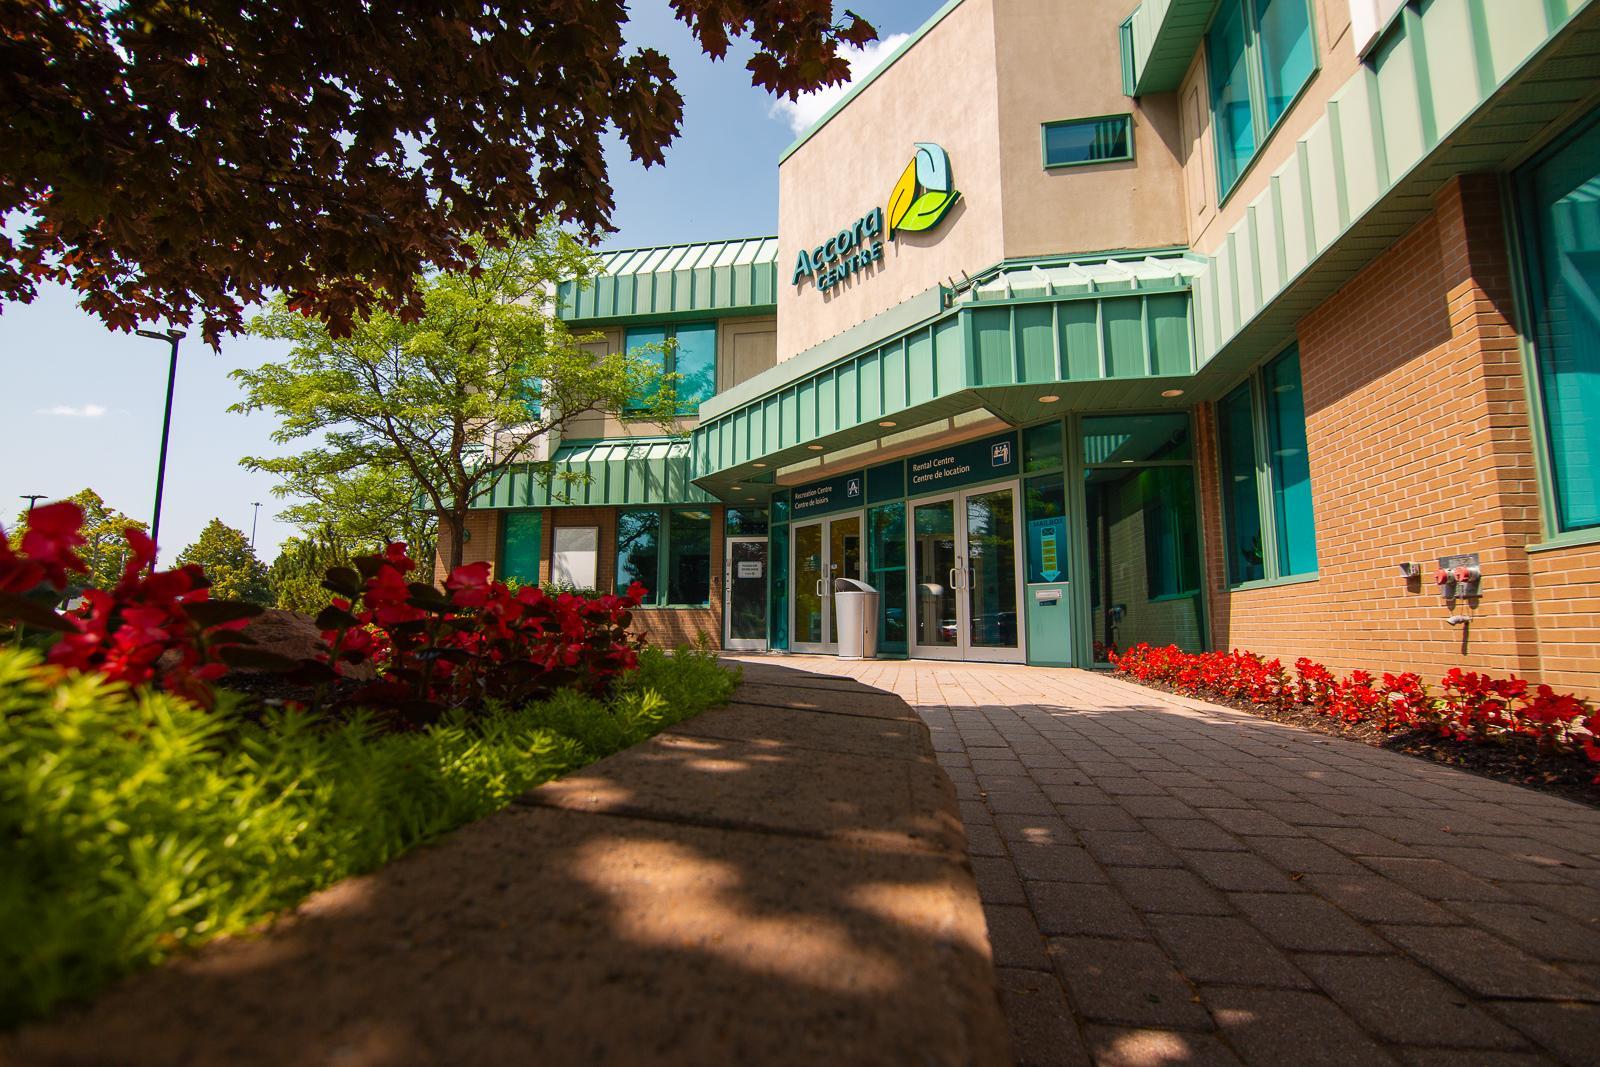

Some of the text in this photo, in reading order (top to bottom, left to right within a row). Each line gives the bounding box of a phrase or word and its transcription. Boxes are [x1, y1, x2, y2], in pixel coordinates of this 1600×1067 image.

[792, 206, 882, 285] Accora
[817, 241, 882, 291] CENTRE
[913, 456, 955, 471] Rental Centre
[913, 465, 970, 483] Centre de location
[795, 486, 832, 499] Recreation Centre
[795, 501, 808, 509] Centre
